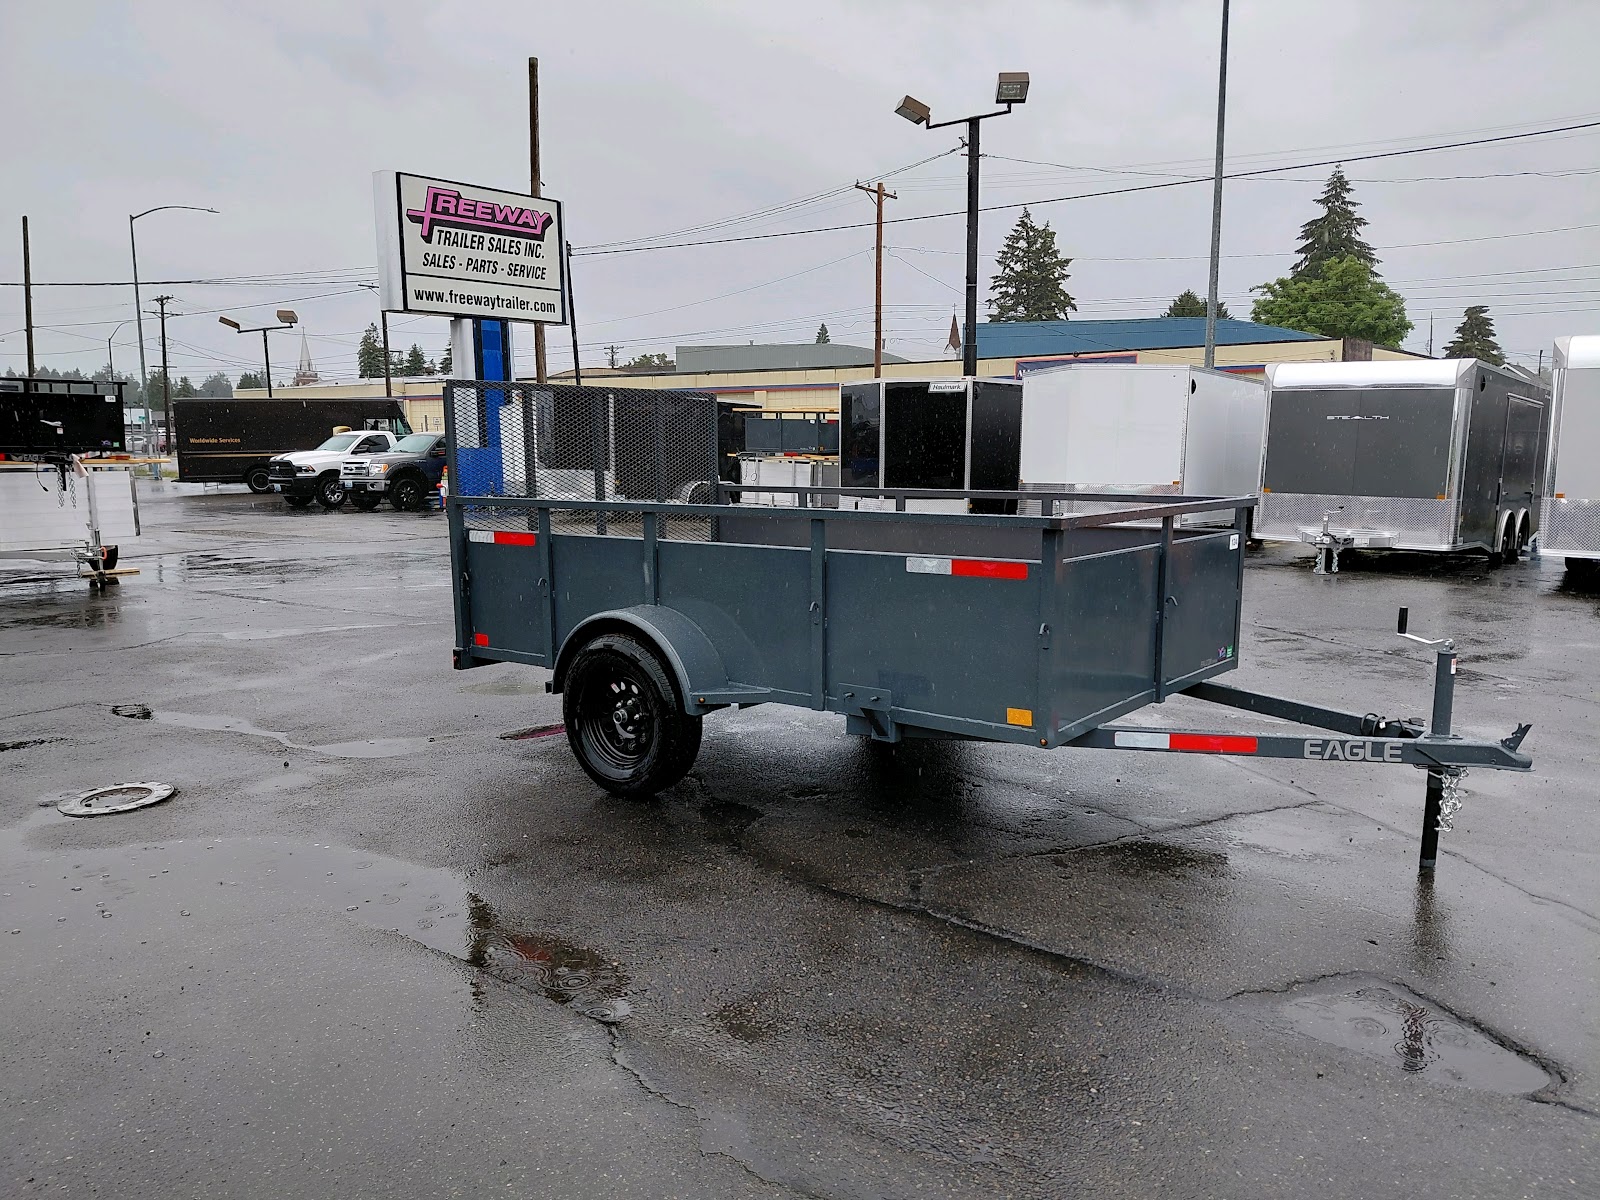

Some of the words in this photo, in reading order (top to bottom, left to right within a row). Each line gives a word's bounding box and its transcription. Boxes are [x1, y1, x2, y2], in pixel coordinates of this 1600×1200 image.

[406, 186, 553, 240] FREEWAY
[437, 229, 485, 251] TRAILER
[487, 236, 522, 256] SALES
[523, 241, 546, 260] INC.
[422, 252, 456, 270] SALES
[465, 257, 499, 275] PARTS
[506, 262, 547, 281] SERVICE
[413, 289, 556, 314] www.freewaytrailer.com
[1303, 739, 1403, 763] EAGLE
